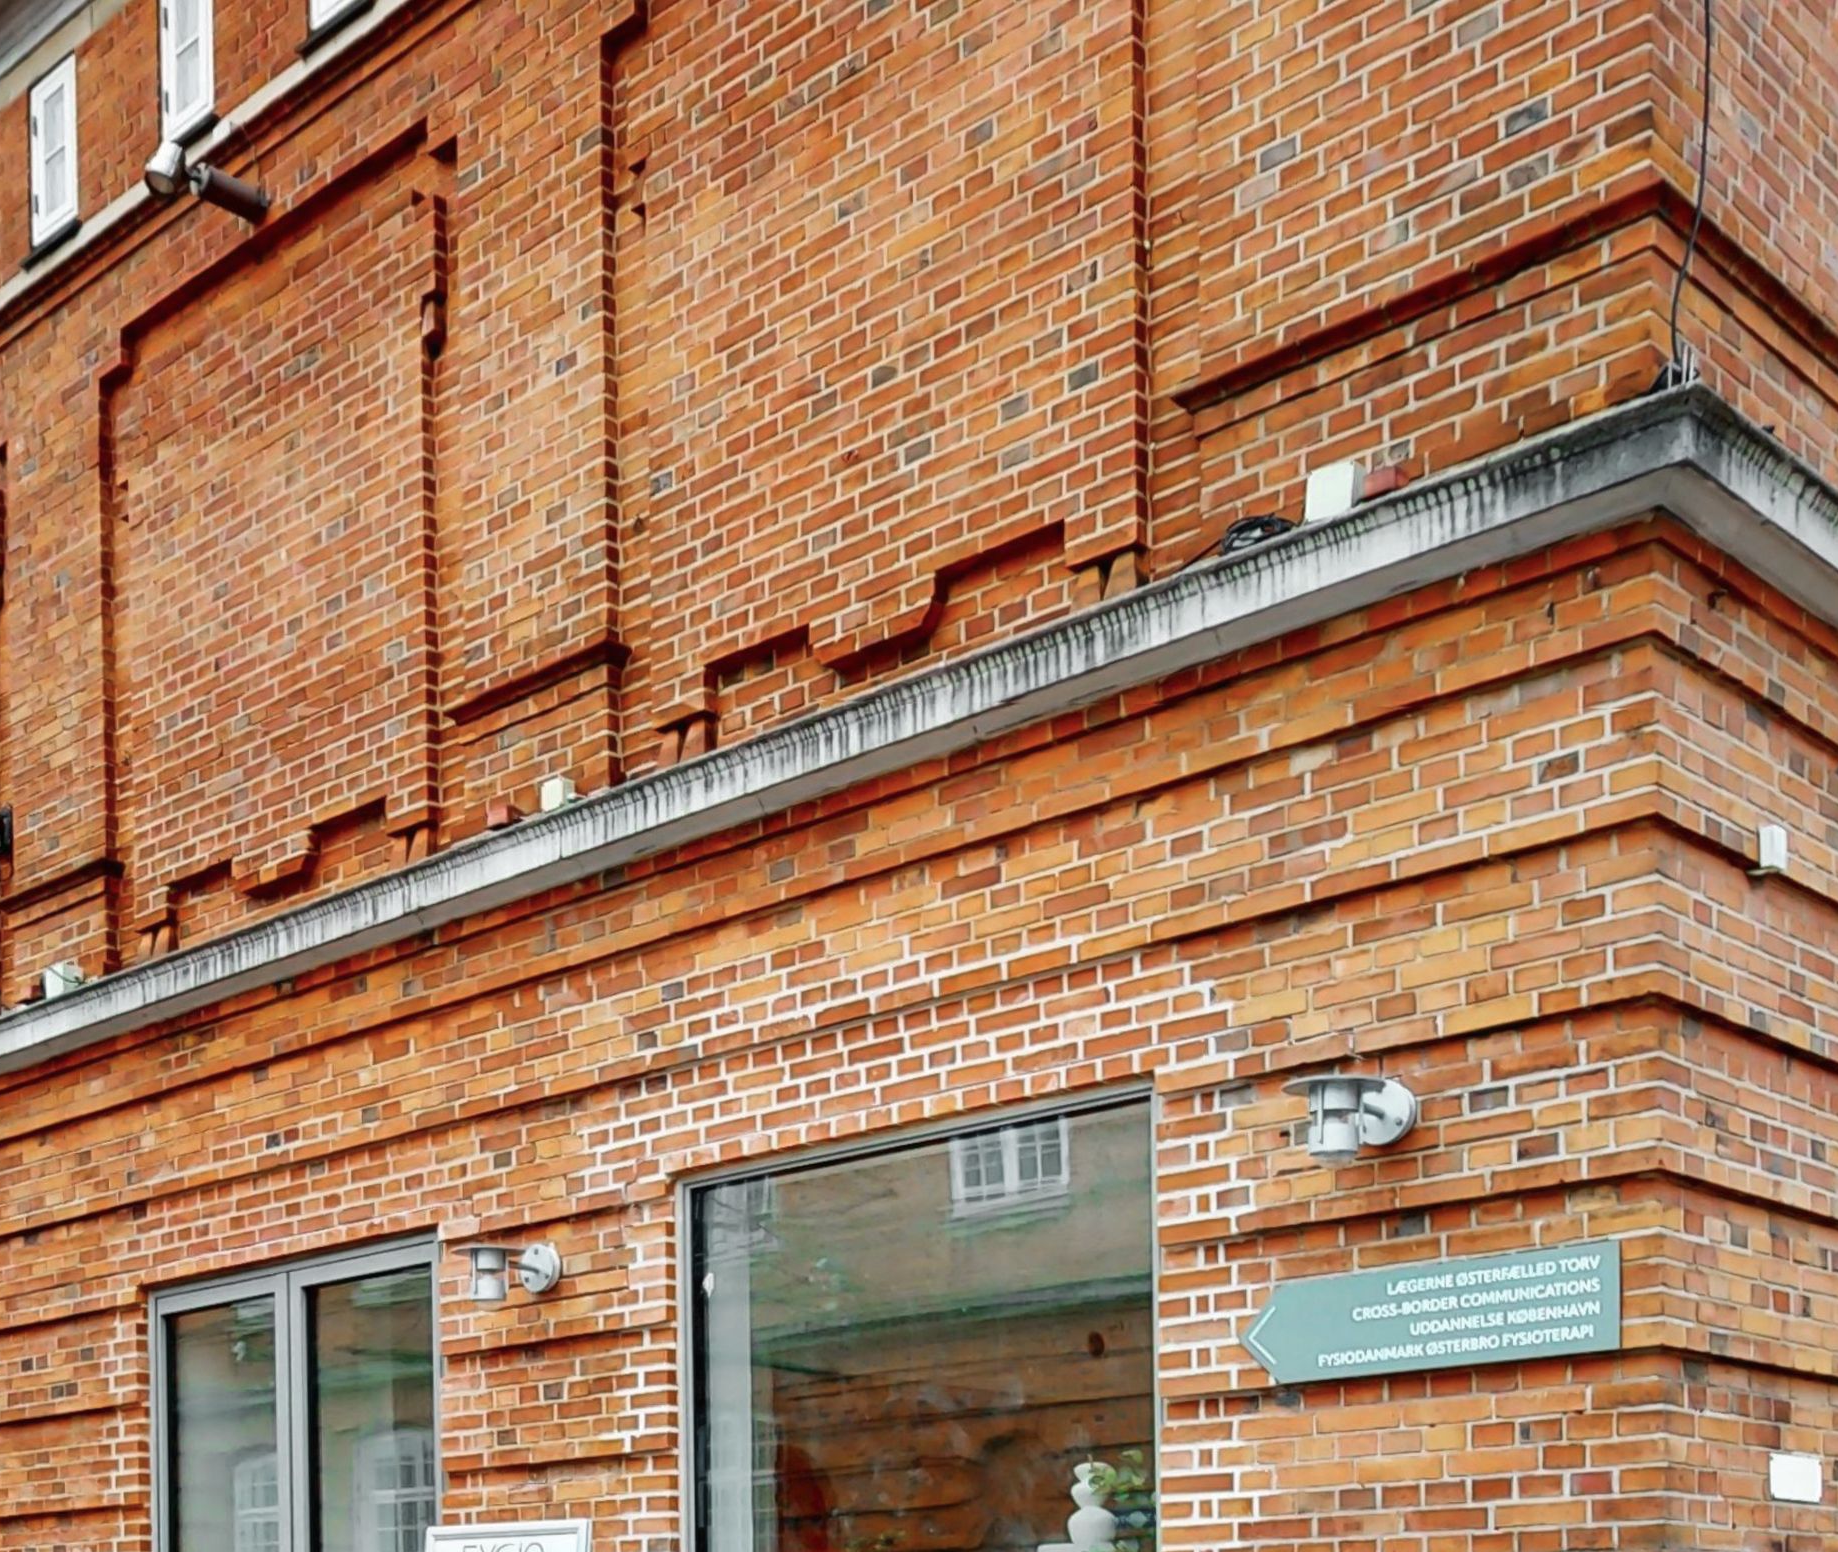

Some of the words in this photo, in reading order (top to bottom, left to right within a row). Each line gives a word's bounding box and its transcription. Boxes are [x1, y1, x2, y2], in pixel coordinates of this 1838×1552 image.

[1387, 1273, 1454, 1296] LÆGERNE
[1456, 1260, 1557, 1287] ØSTERFÆLLED
[1558, 1254, 1601, 1273] TORV
[1352, 1296, 1459, 1321] CROSS-BORDER
[1460, 1277, 1601, 1308] COMMUNICATIONS
[1409, 1310, 1504, 1336] UDDANNELSE
[1507, 1300, 1601, 1324] KØBENHAVN
[1318, 1343, 1425, 1367] FYSIODANMARK
[1426, 1335, 1500, 1357] ØSTERBRO
[1502, 1324, 1594, 1348] FYSIOTERAPI
